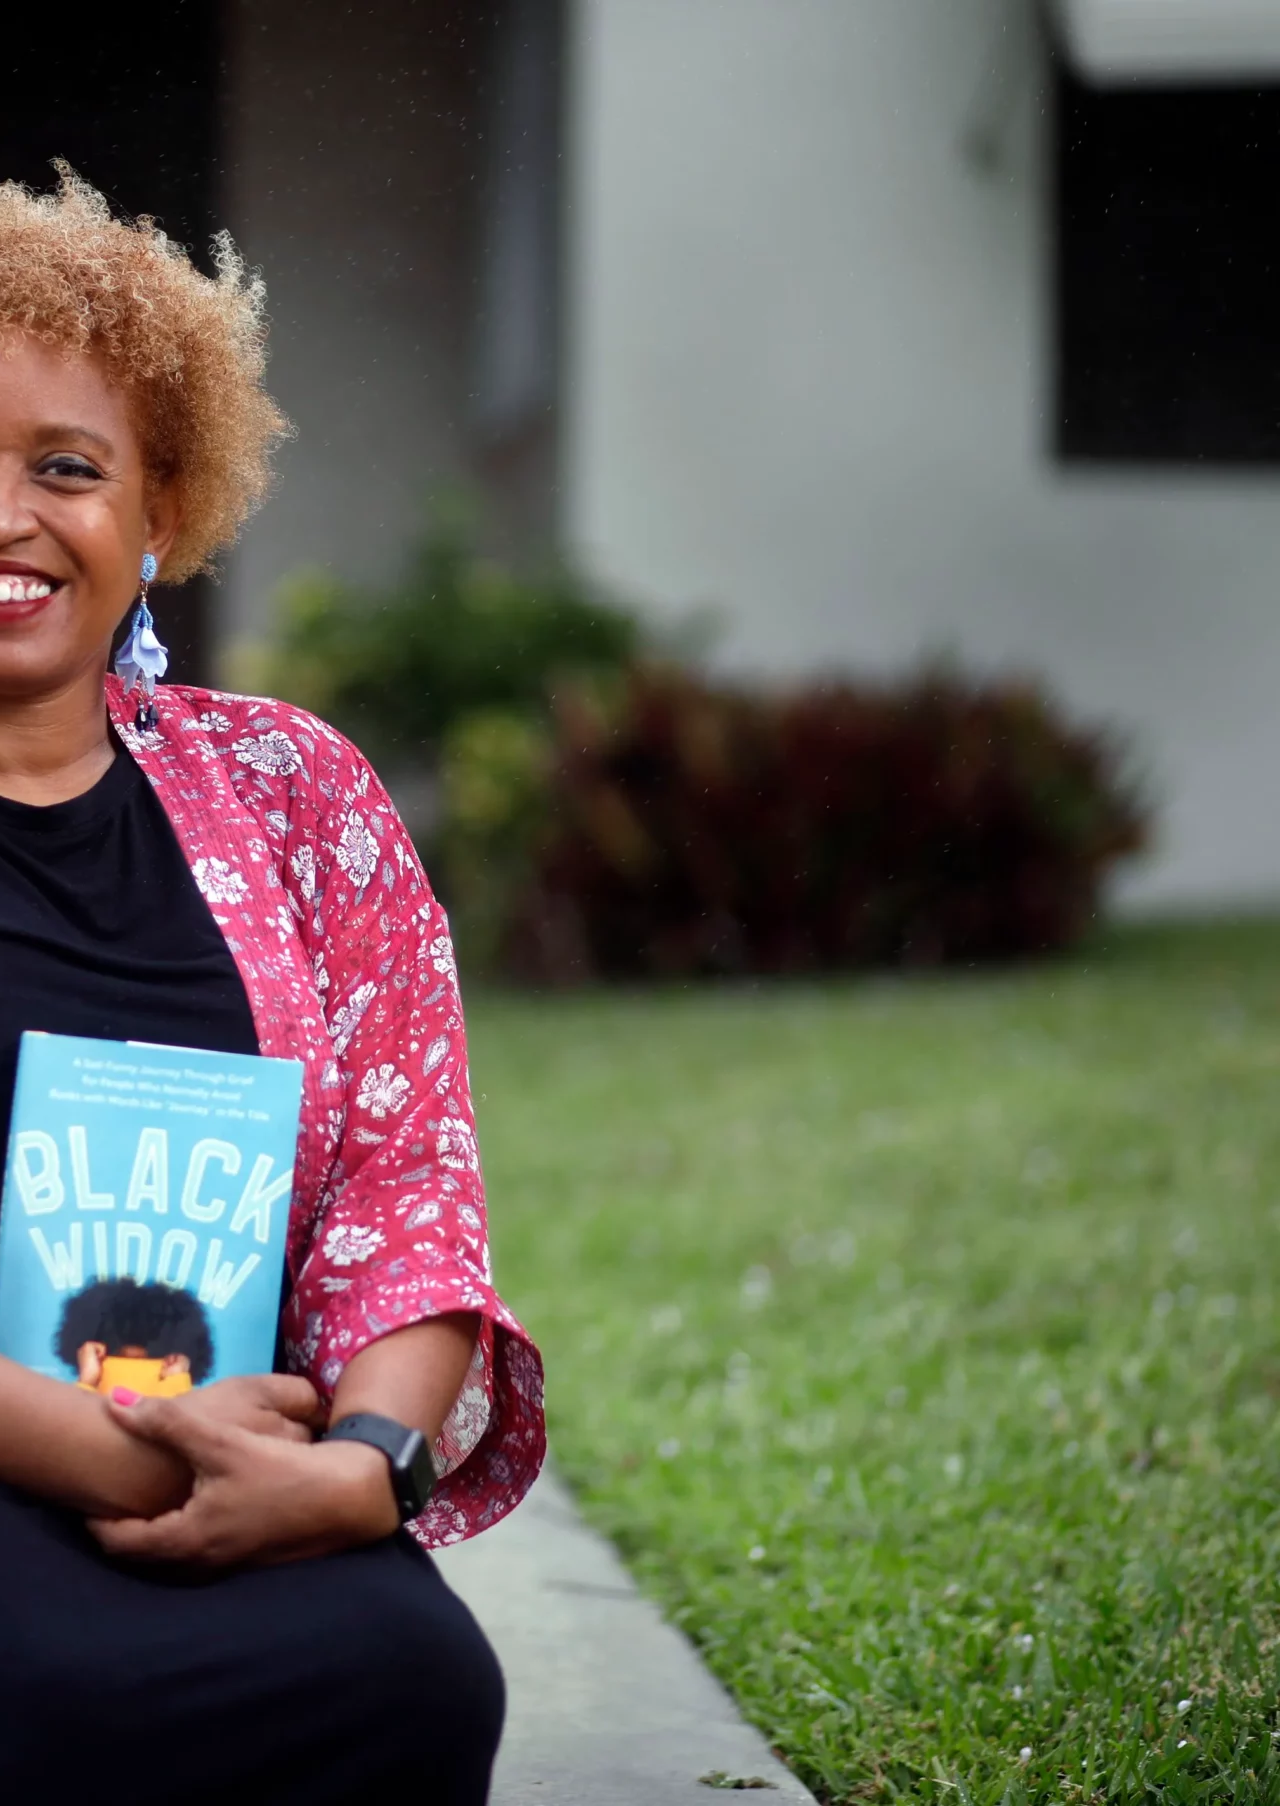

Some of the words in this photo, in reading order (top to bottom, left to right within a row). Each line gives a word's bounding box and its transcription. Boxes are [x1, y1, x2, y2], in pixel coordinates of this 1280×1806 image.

[100, 1076, 135, 1090] People
[184, 1068, 226, 1085] Through
[14, 1125, 294, 1244] BLACK
[28, 1221, 262, 1310] WIDOW
